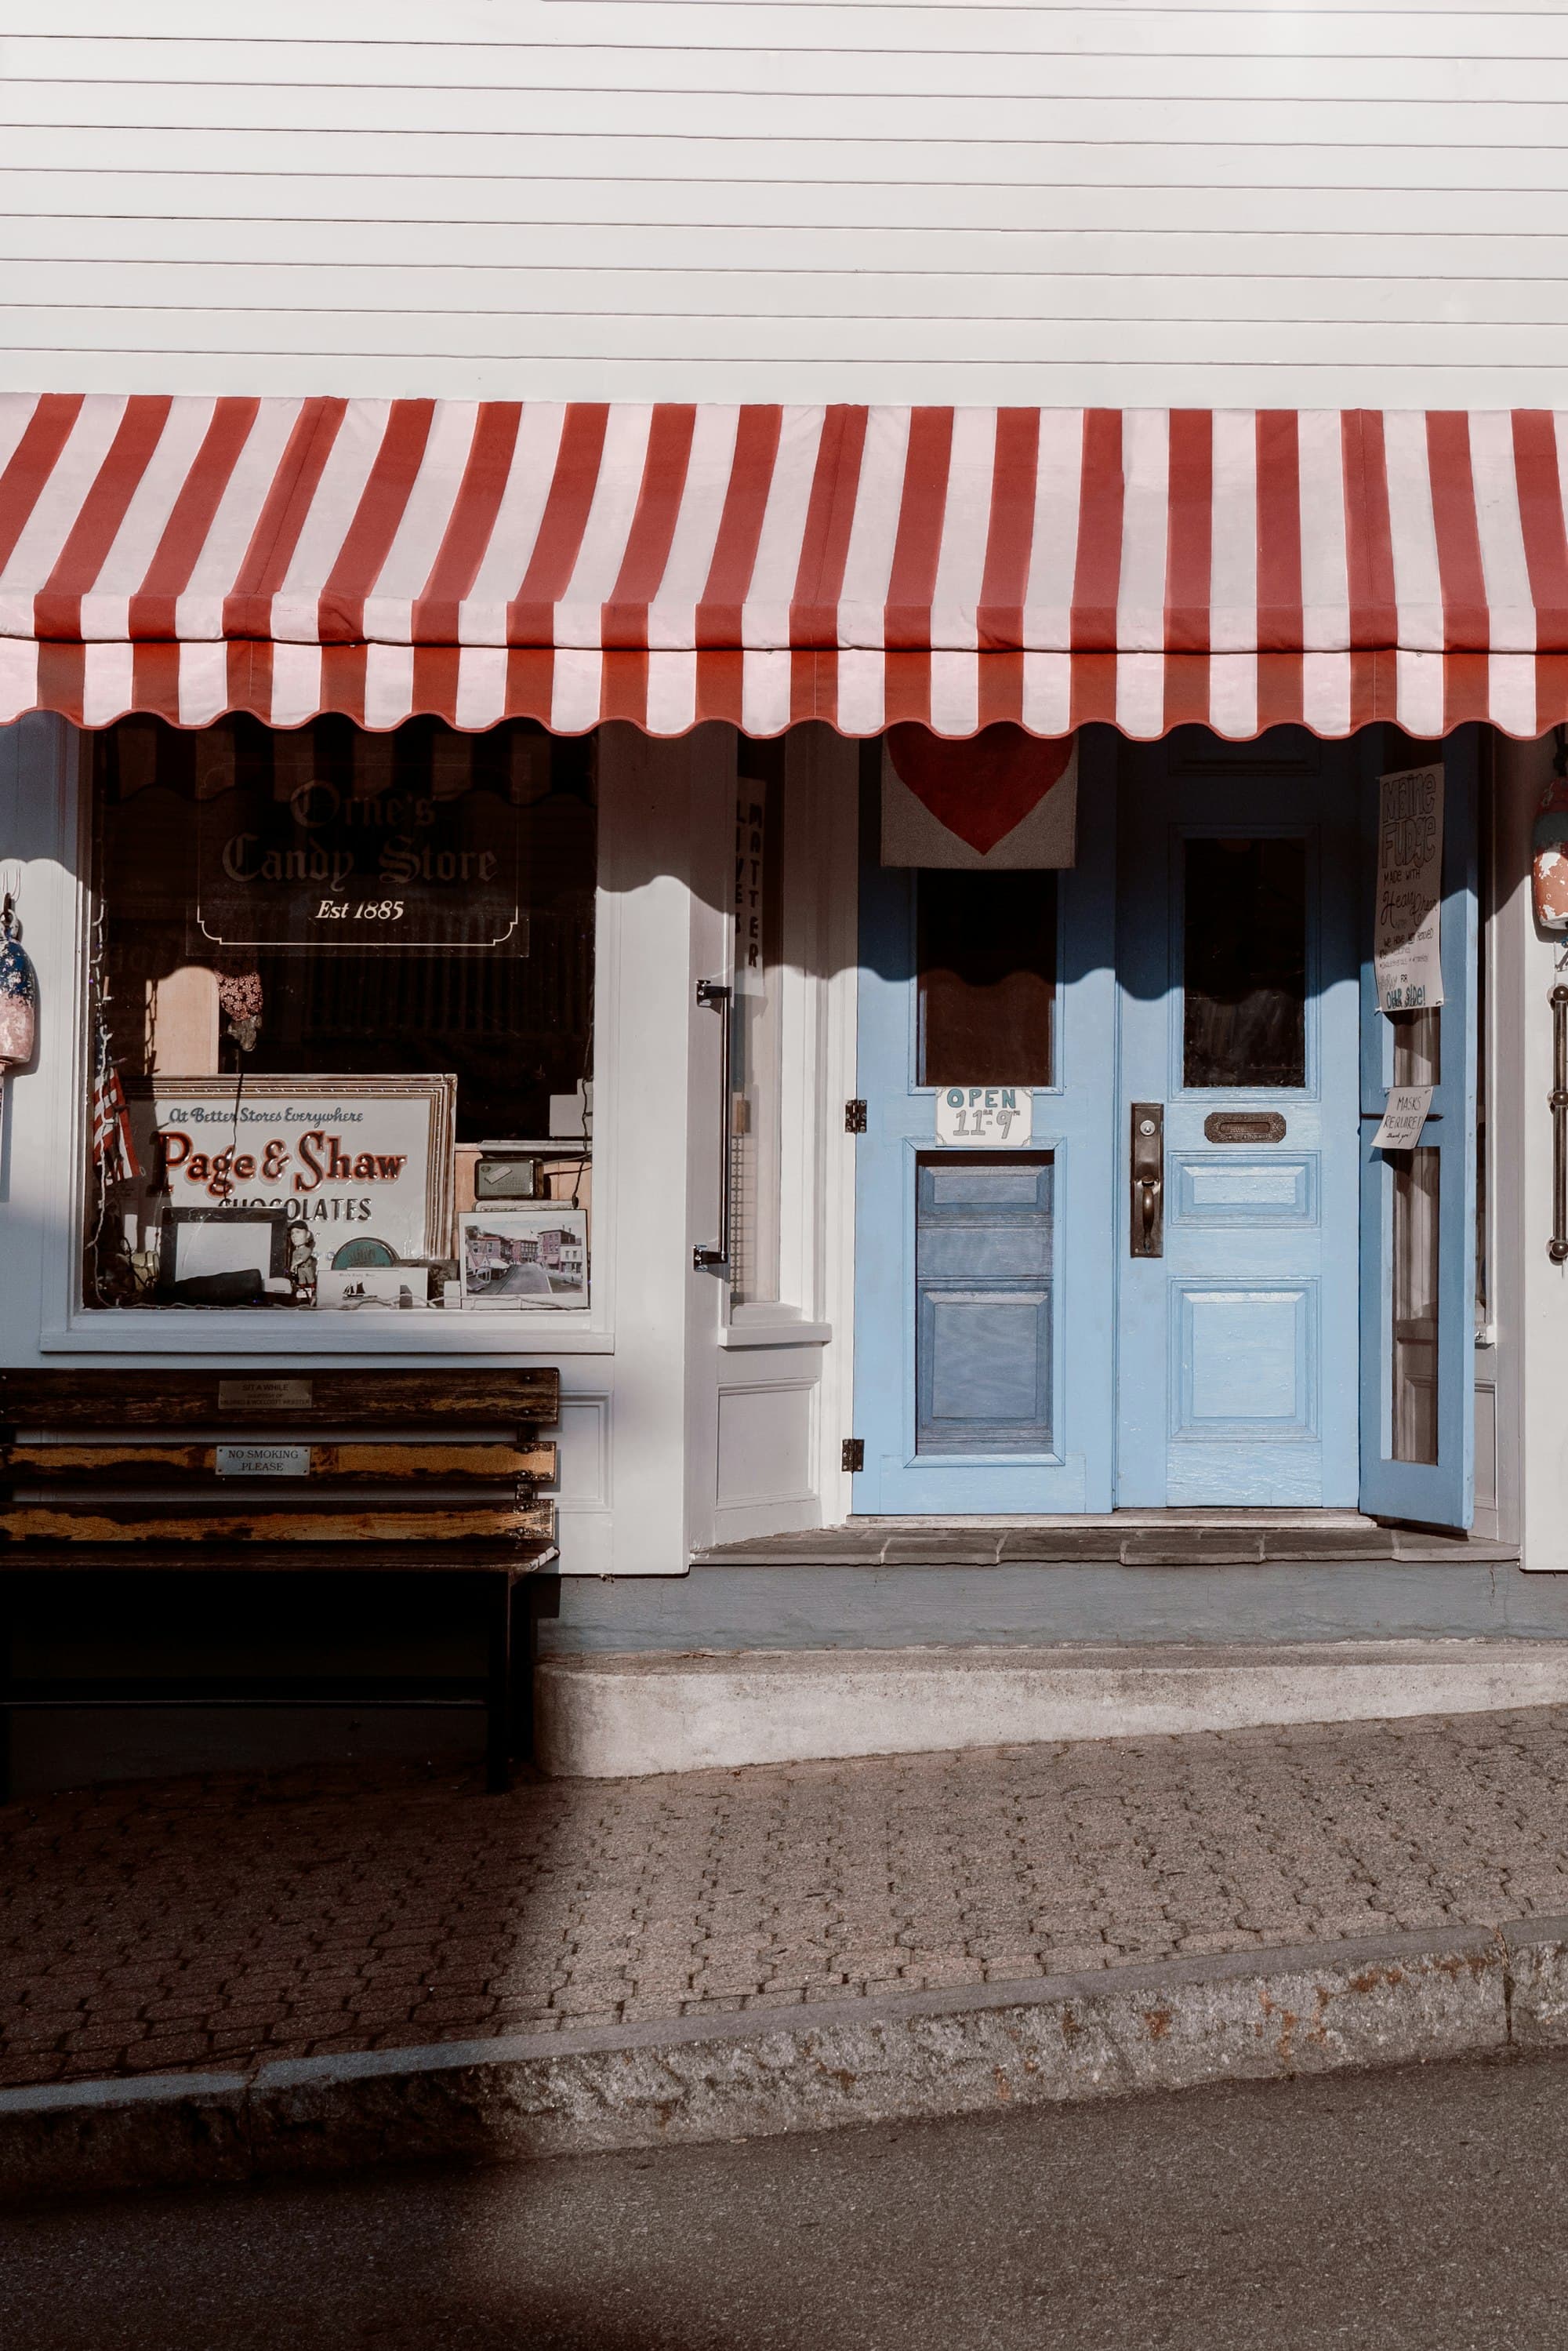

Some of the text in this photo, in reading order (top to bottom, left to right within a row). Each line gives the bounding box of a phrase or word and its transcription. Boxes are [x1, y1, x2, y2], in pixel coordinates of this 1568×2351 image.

[290, 779, 437, 828] Orne's
[222, 833, 498, 892] Candy Store
[748, 802, 762, 968] MATTER
[315, 899, 405, 920] Est 1885
[946, 1088, 1016, 1109] OPEN
[1397, 1096, 1421, 1111] MASKS
[169, 1106, 365, 1128] At Better Stores Everywhere
[147, 1129, 408, 1197] Page & Shaw
[228, 1449, 299, 1459] NO SMOKING
[241, 1462, 284, 1471] PLEASE
